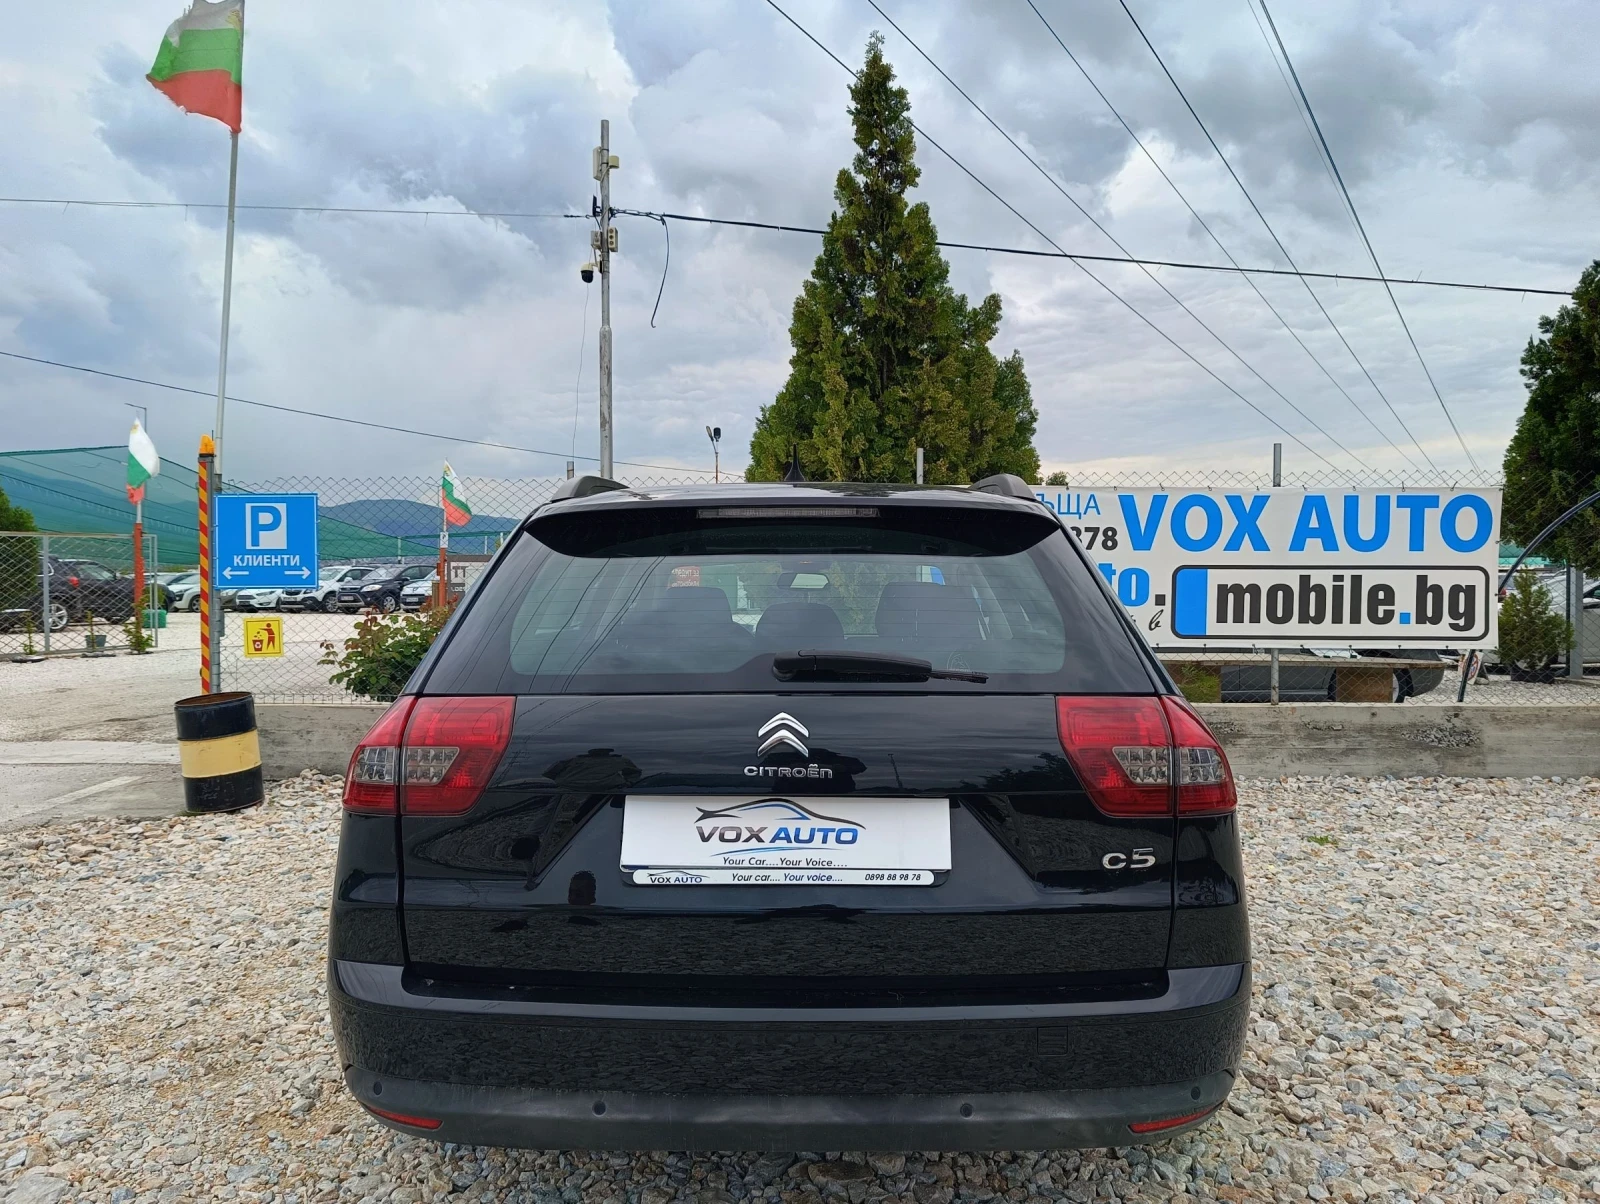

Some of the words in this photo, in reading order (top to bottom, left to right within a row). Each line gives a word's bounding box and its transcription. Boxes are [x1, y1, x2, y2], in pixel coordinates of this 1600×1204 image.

[251, 505, 282, 547] P
[1117, 494, 1271, 552] VOX
[1288, 494, 1493, 552] AUTO
[234, 555, 300, 567] КЛИЕНТИ
[1216, 575, 1477, 632] mobile.bg
[743, 763, 833, 779] CITROËN
[696, 826, 768, 843] VOX
[769, 827, 859, 845] AUTO
[723, 856, 745, 866] Your
[1102, 847, 1156, 869] C5
[650, 876, 671, 884] VOX
[674, 876, 703, 884] AUTO
[732, 872, 753, 882] Your
[784, 872, 804, 882] Your
[864, 873, 885, 882] 0898
[886, 873, 897, 882] 88
[899, 873, 909, 882] 98
[911, 873, 921, 882] 78
